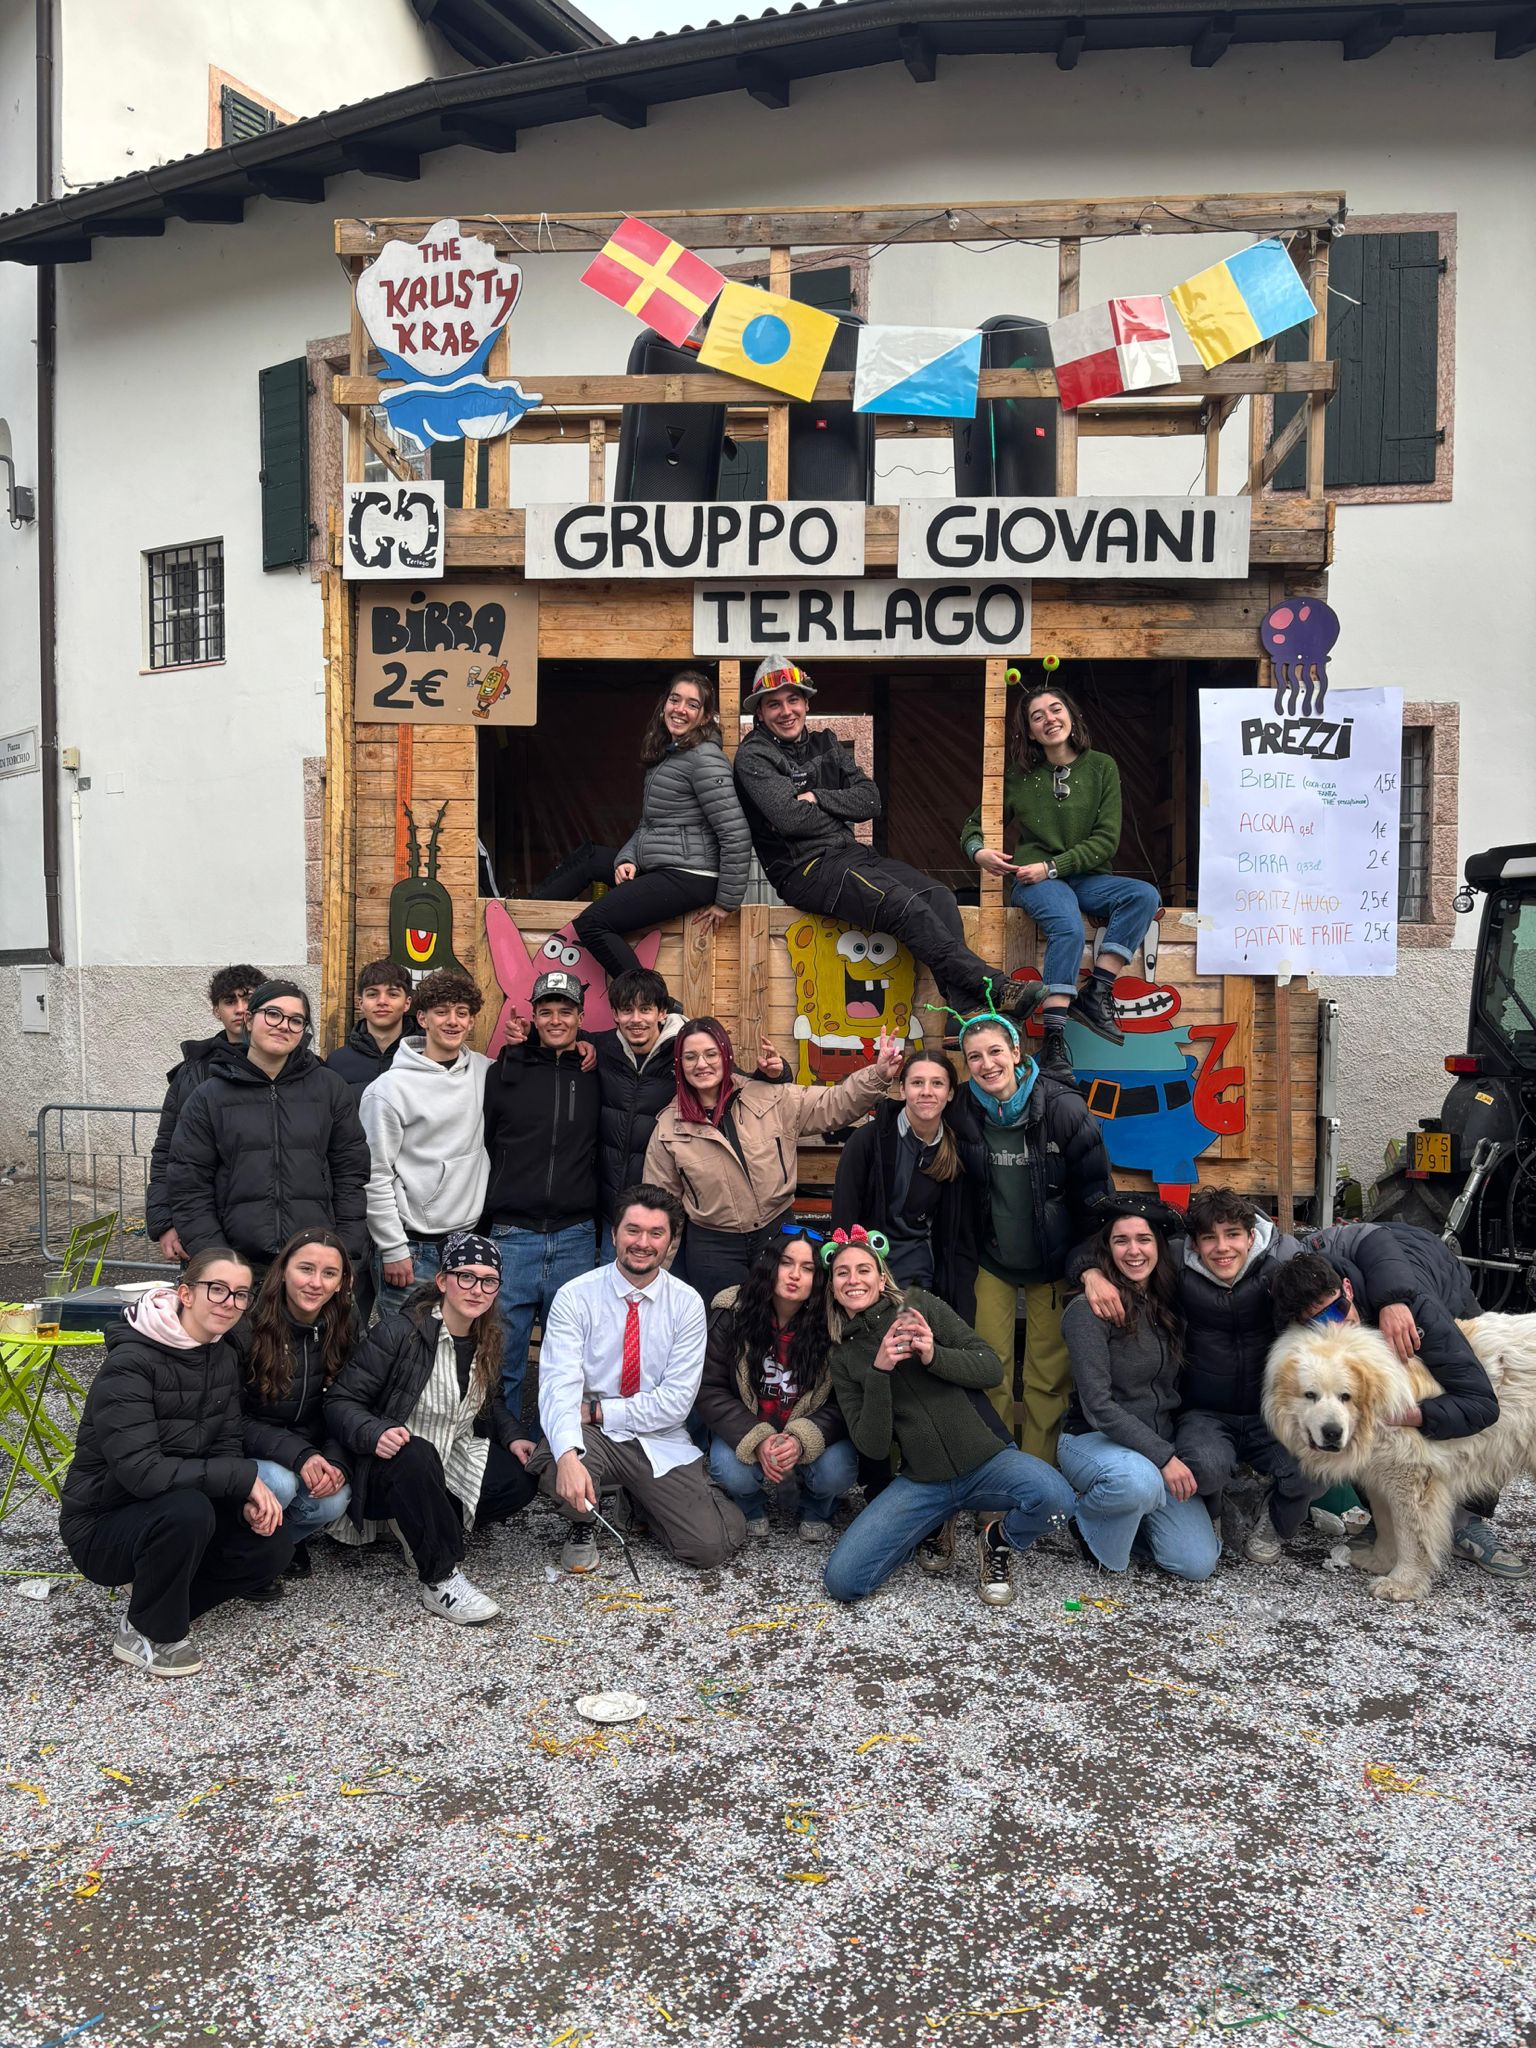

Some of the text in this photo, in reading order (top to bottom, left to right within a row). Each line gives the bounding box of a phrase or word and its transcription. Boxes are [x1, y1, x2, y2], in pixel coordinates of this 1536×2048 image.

[418, 237, 461, 263] THE
[379, 269, 519, 327] KRUSTY
[392, 321, 480, 356] KRAB
[554, 504, 1216, 570] GRUPPO GIOVANI
[703, 583, 1024, 645] TERLAGO
[373, 661, 448, 709] 2€
[7, 743, 20, 752] Piazza
[1240, 768, 1295, 789] BIBITE
[1373, 773, 1397, 794] 1,5€
[1239, 812, 1295, 834] ACQUA
[1370, 820, 1388, 840] 1€
[1238, 851, 1289, 874] BIRRA
[1359, 890, 1389, 912] 2,5€
[1234, 921, 1391, 949] PATATINE FRITTE 2,5€
[1416, 1136, 1431, 1152] BY
